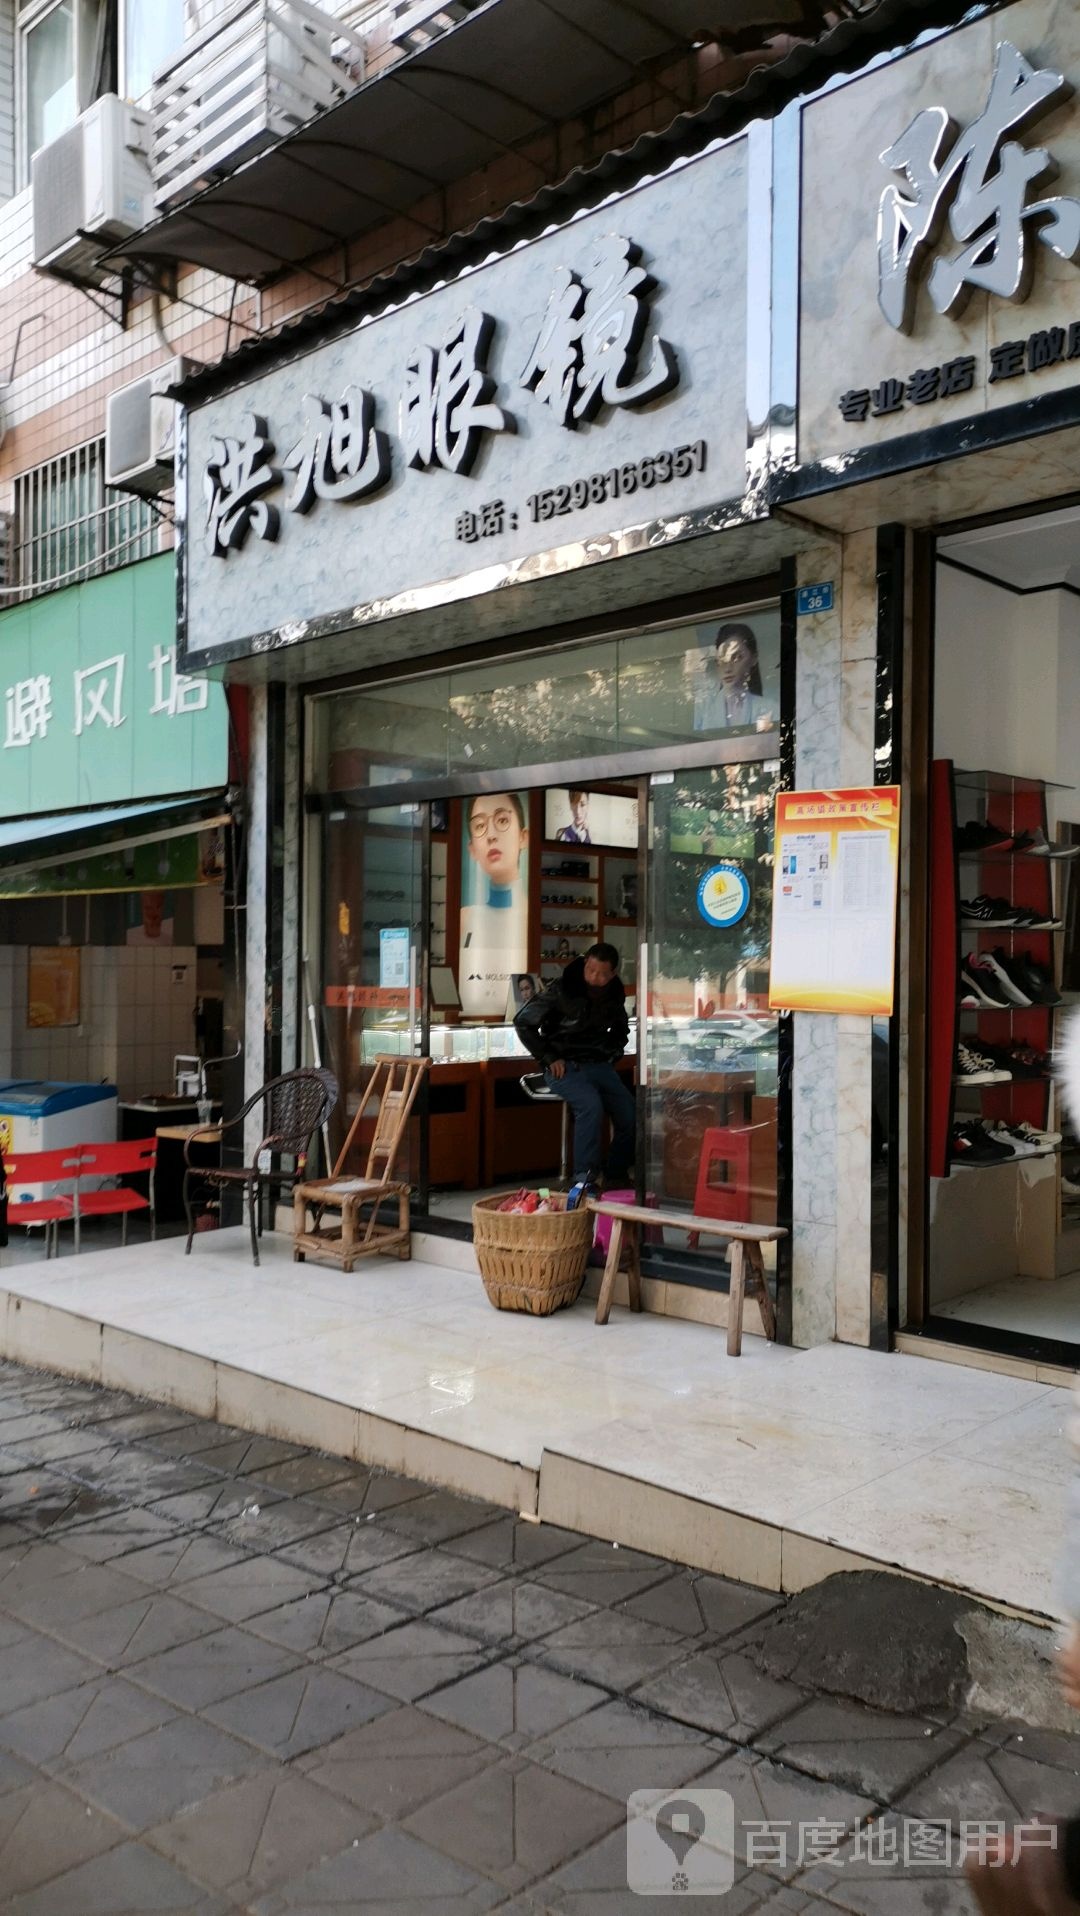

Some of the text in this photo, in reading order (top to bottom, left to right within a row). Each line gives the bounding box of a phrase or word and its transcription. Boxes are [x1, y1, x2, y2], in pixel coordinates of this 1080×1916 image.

[205, 231, 680, 558] 洪旭眼镜
[838, 354, 976, 422] 专业老店
[808, 596, 823, 609] 36
